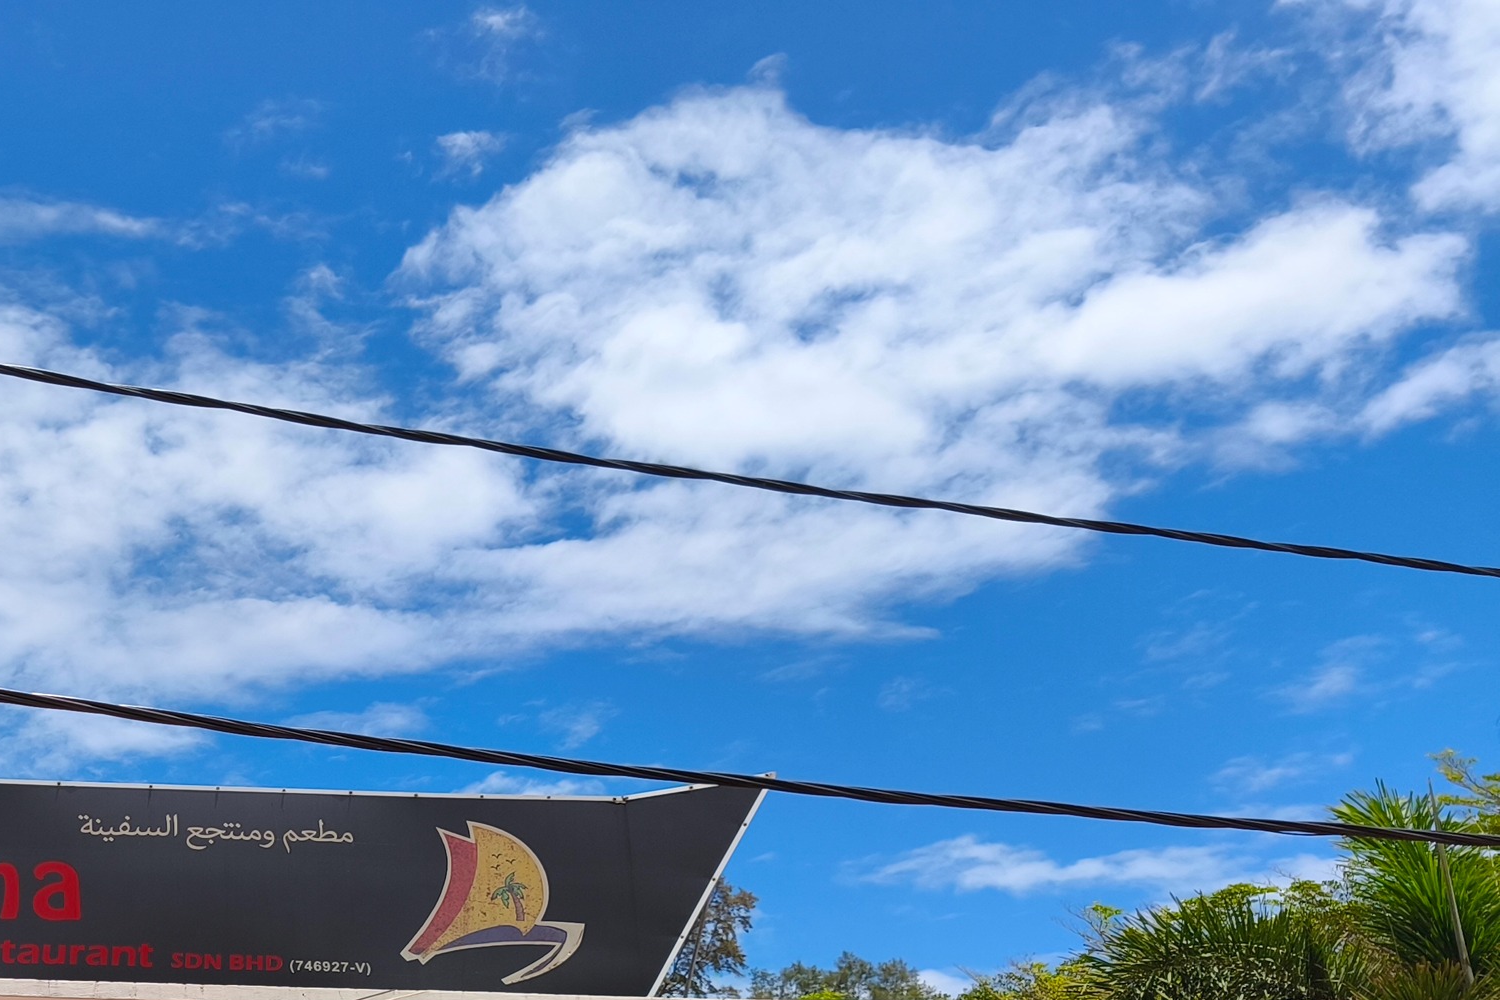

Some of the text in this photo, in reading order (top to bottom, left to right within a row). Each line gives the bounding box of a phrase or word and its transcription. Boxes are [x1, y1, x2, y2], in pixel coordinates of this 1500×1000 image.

[77, 814, 354, 853] مطعم ومنتجع السفينة
[170, 952, 222, 971] SDN
[228, 955, 284, 972] BHD
[289, 959, 372, 976] (746927-V)
